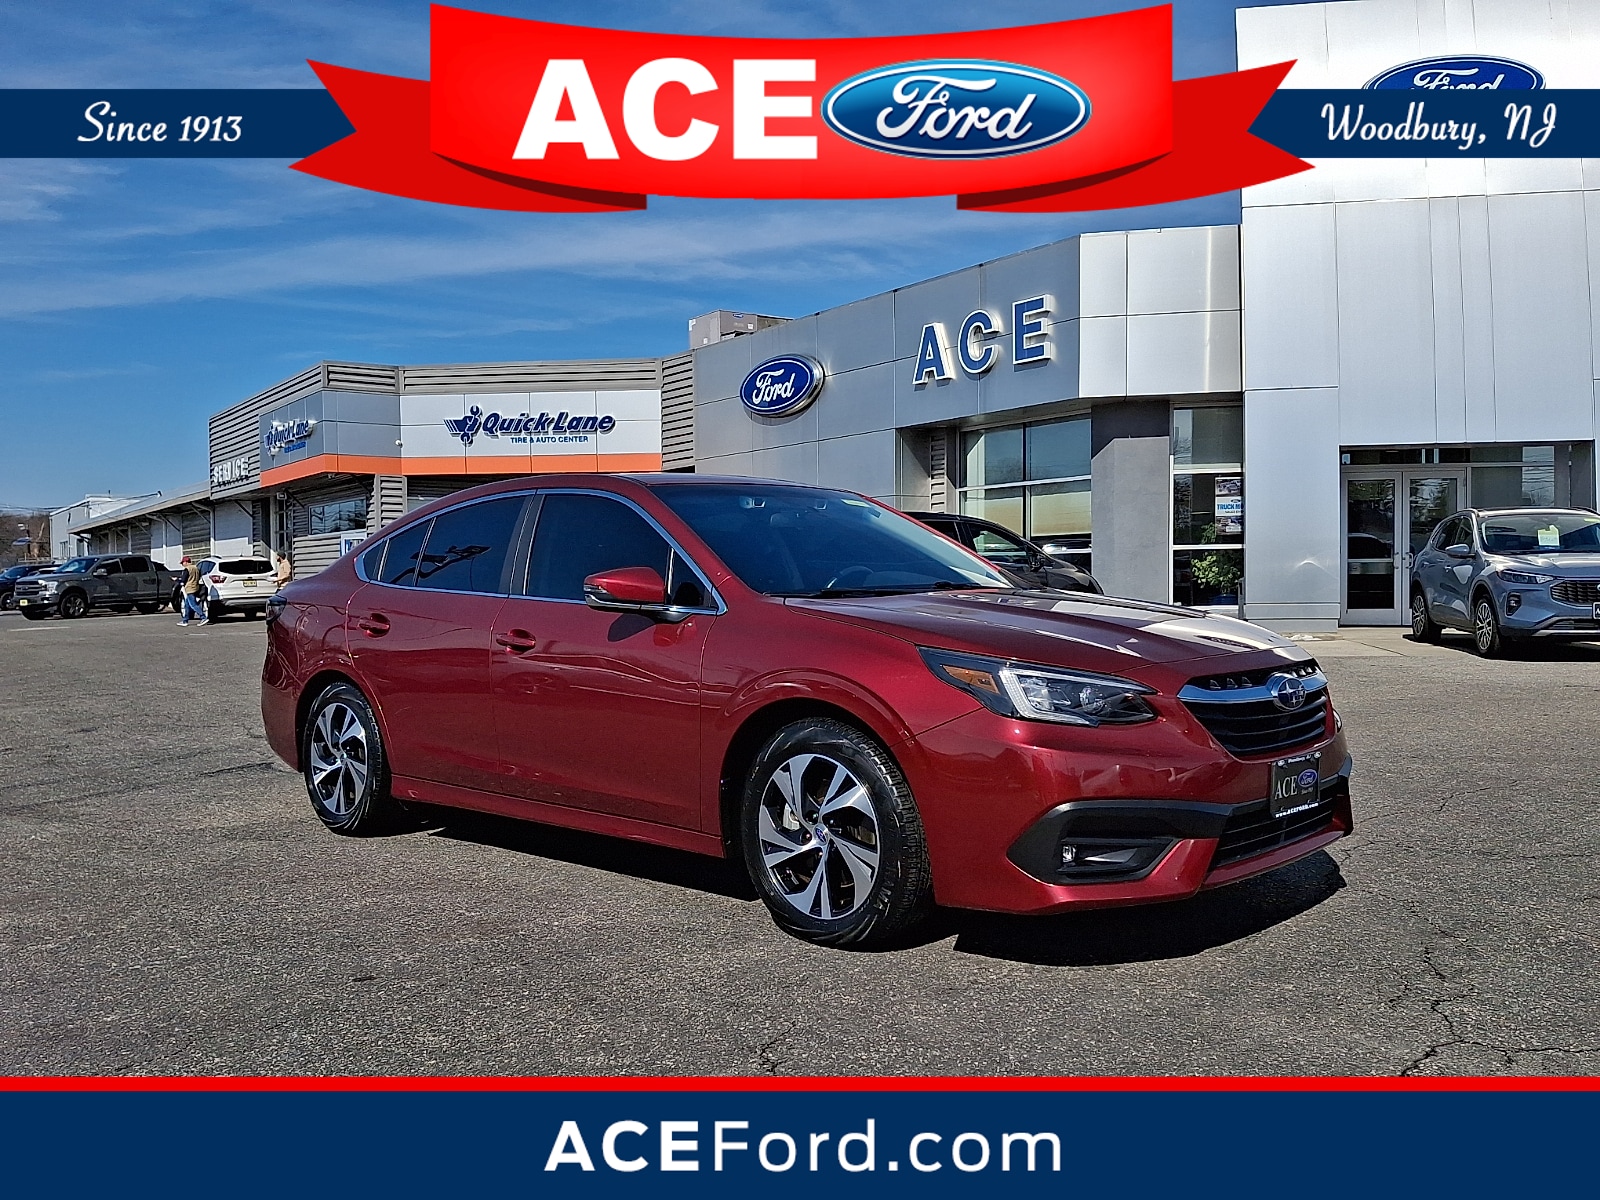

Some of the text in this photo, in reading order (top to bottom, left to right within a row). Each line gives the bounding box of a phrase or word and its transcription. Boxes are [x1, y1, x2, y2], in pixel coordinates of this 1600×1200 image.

[912, 293, 1054, 385] ACE
[751, 368, 795, 405] Ford
[482, 411, 616, 435] Quick Lane
[510, 436, 528, 444] TIRE
[536, 436, 557, 444] AUTO
[558, 435, 589, 444] CENTER
[213, 457, 249, 483] SERVICE
[1217, 503, 1235, 511] TRUCK
[1274, 776, 1298, 800] ACE
